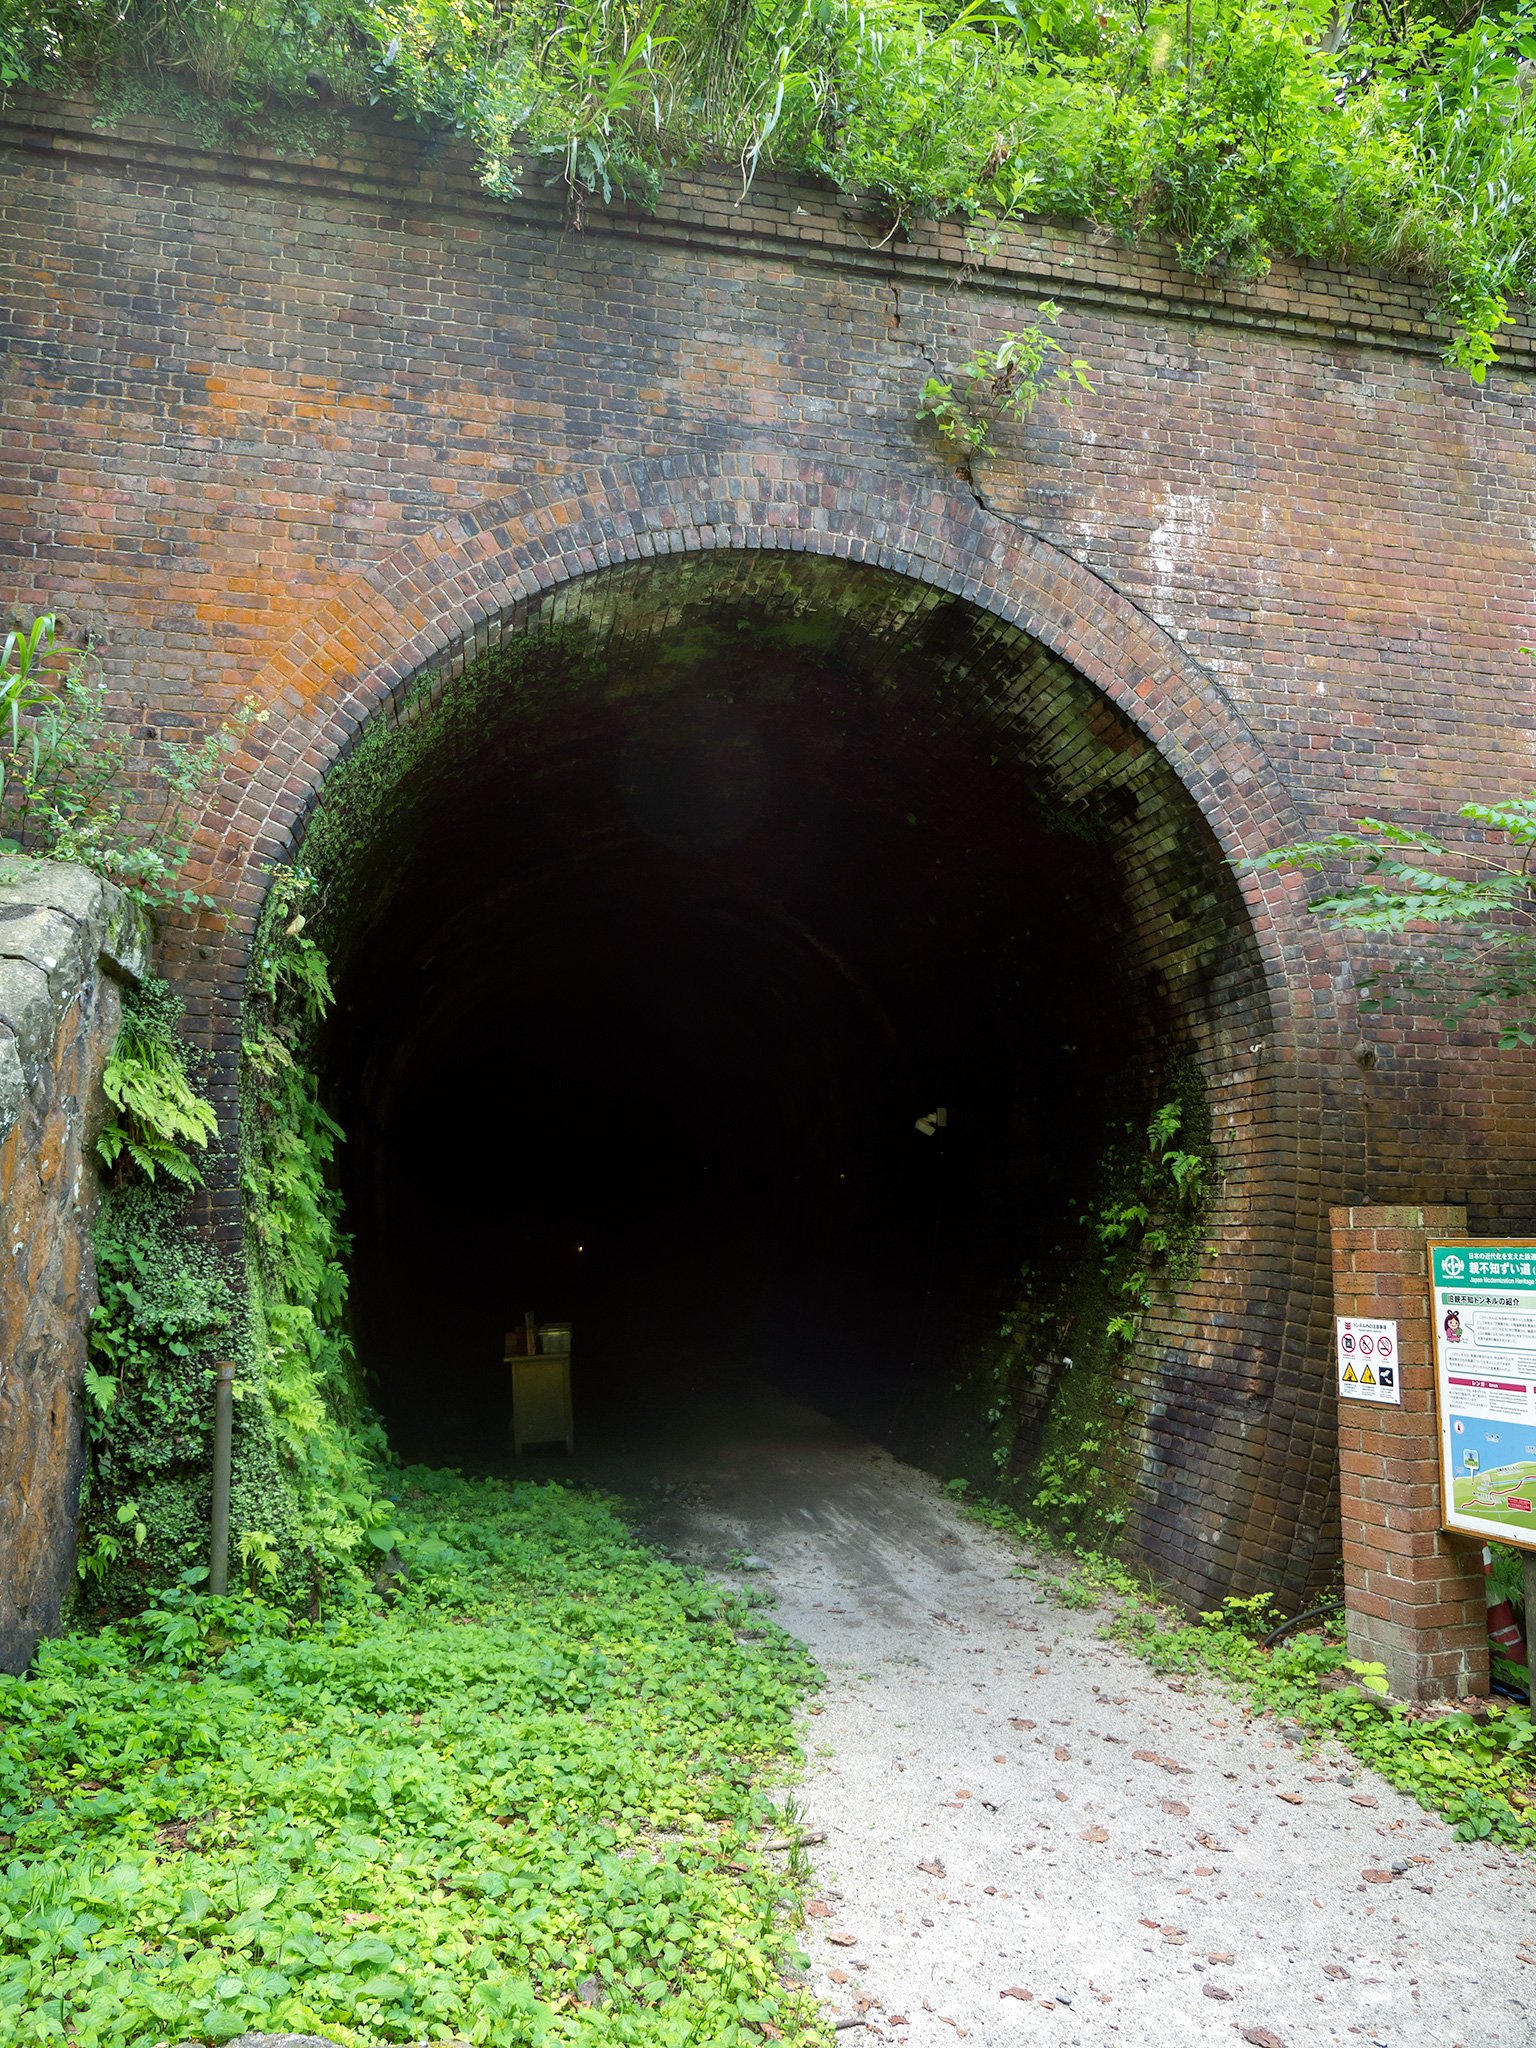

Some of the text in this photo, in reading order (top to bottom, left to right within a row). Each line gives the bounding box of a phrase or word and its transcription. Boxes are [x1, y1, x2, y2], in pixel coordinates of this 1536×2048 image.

[1515, 1278, 1535, 1286] Heritage
[1448, 1295, 1520, 1306] 旧親不知トンネルの紹介
